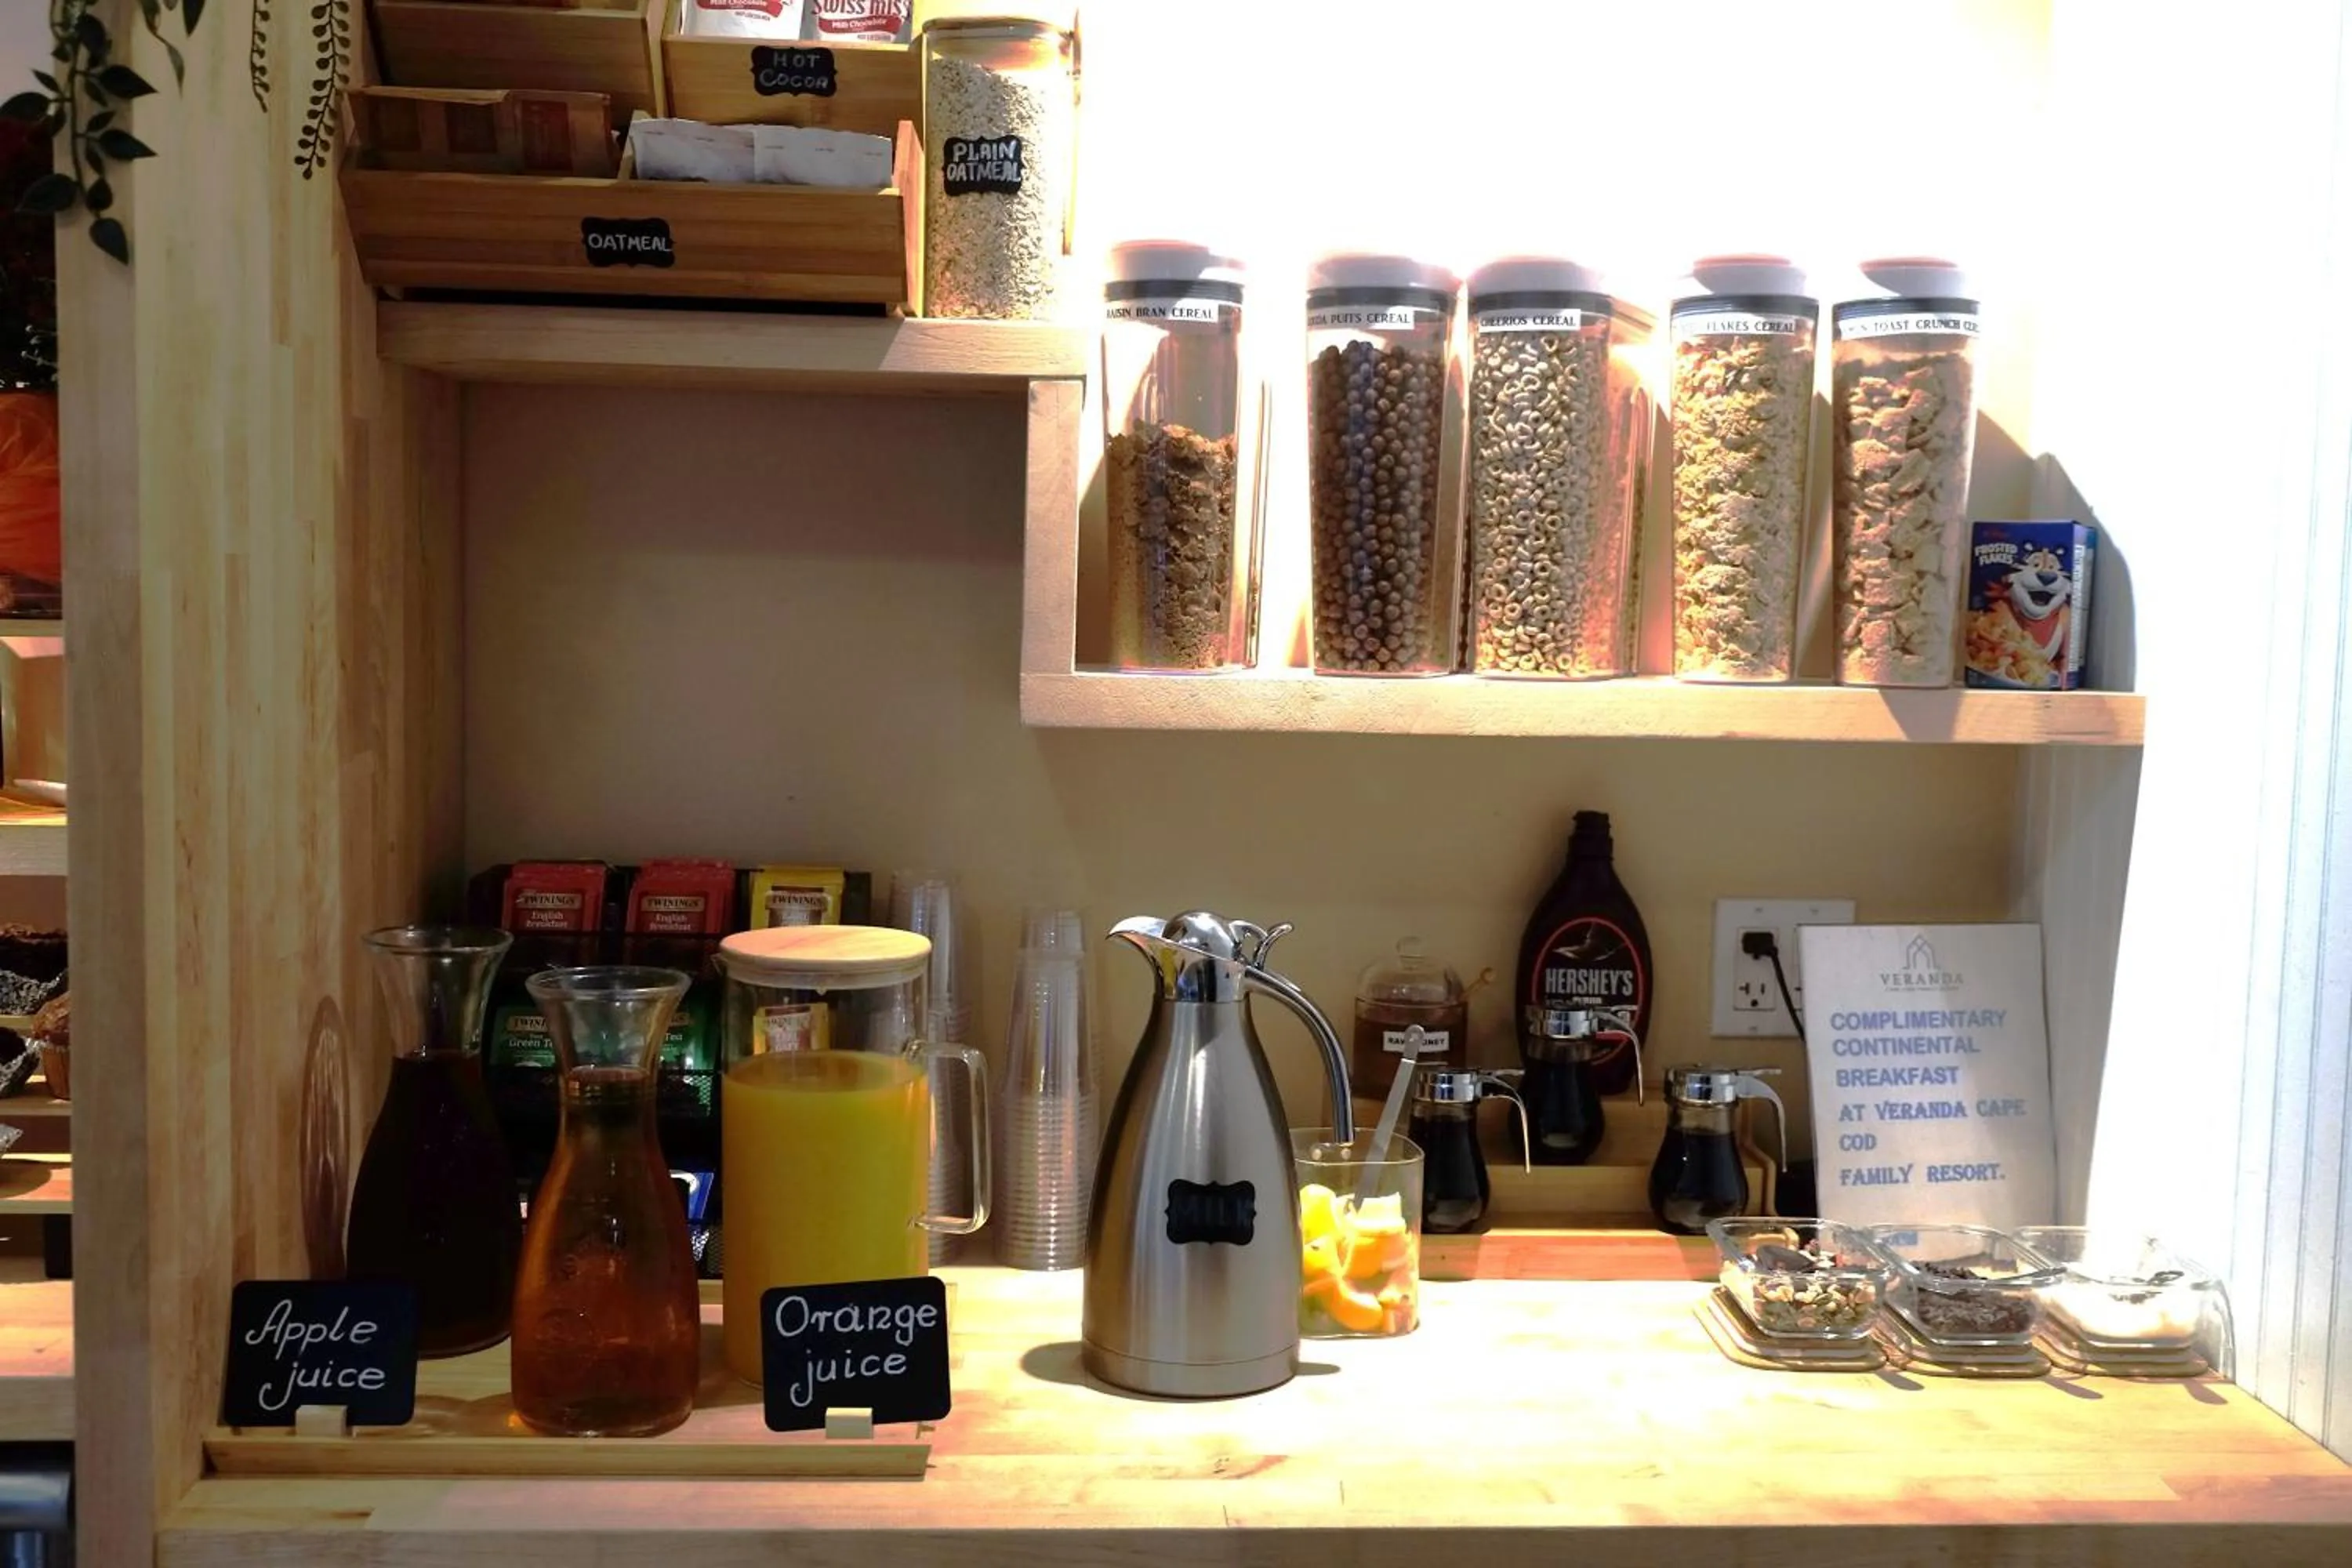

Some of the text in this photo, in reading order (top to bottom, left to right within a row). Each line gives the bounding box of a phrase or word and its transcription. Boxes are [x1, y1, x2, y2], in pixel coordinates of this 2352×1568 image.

[773, 53, 820, 67] HOT
[760, 69, 828, 89] COCOA
[953, 140, 1017, 162] PLAIN
[946, 160, 1021, 182] OATMEAL
[588, 233, 672, 251] OATMEAL
[1136, 307, 1166, 318] BRAN
[1172, 307, 1213, 319] CEREAL
[1367, 314, 1410, 324] CEREAL
[1533, 314, 1576, 326] CEREAL
[1707, 321, 1749, 332] FLAKES
[1755, 321, 1794, 332] CEREAL
[1875, 319, 1909, 332] TOAST
[1915, 318, 1960, 330] CRUNCH
[1975, 543, 2018, 556] FROSTED
[1980, 553, 2014, 566] FLAKES
[523, 894, 576, 905] TWININGS
[647, 898, 699, 908] TWININGS
[531, 910, 564, 921] English
[1545, 967, 1633, 996] HERSHEY'S
[1879, 973, 1964, 985] VERANDA
[1831, 1009, 2007, 1031] COMPLIMENTARY
[510, 1037, 539, 1047] Green
[1832, 1036, 1981, 1057] CONTINENTAL
[1836, 1065, 1959, 1087] BREAKFAST
[1838, 1098, 2027, 1122] AT VERANDA CAPE
[1838, 1134, 1877, 1151] COD
[1839, 1163, 2006, 1186] FAMILY RESORT.
[245, 1298, 379, 1361] Apple
[775, 1295, 938, 1347] Orange
[258, 1361, 387, 1411] juice
[790, 1348, 907, 1407] juice
